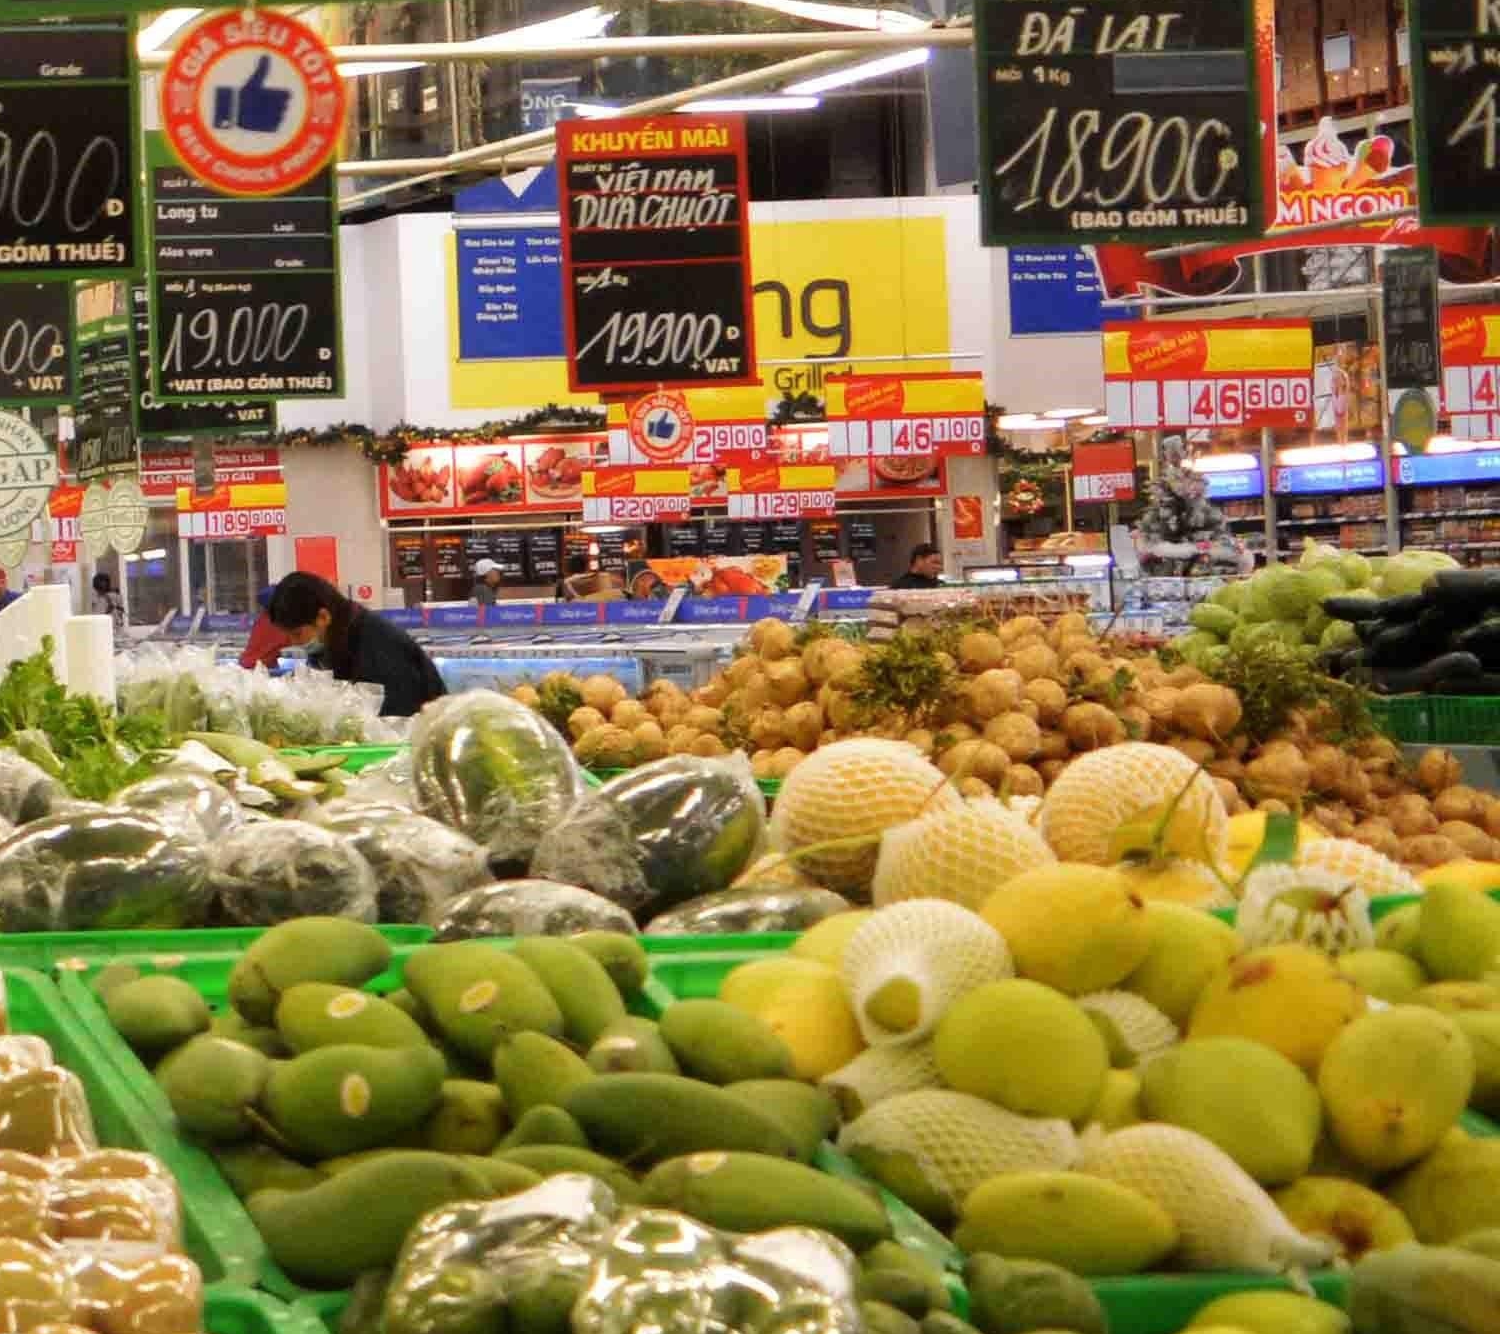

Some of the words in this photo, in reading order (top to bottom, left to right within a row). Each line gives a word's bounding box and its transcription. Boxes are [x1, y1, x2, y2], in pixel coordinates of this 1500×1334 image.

[573, 123, 673, 152] KHUYẾN
[157, 205, 196, 220] Long
[160, 303, 309, 372] 19.000
